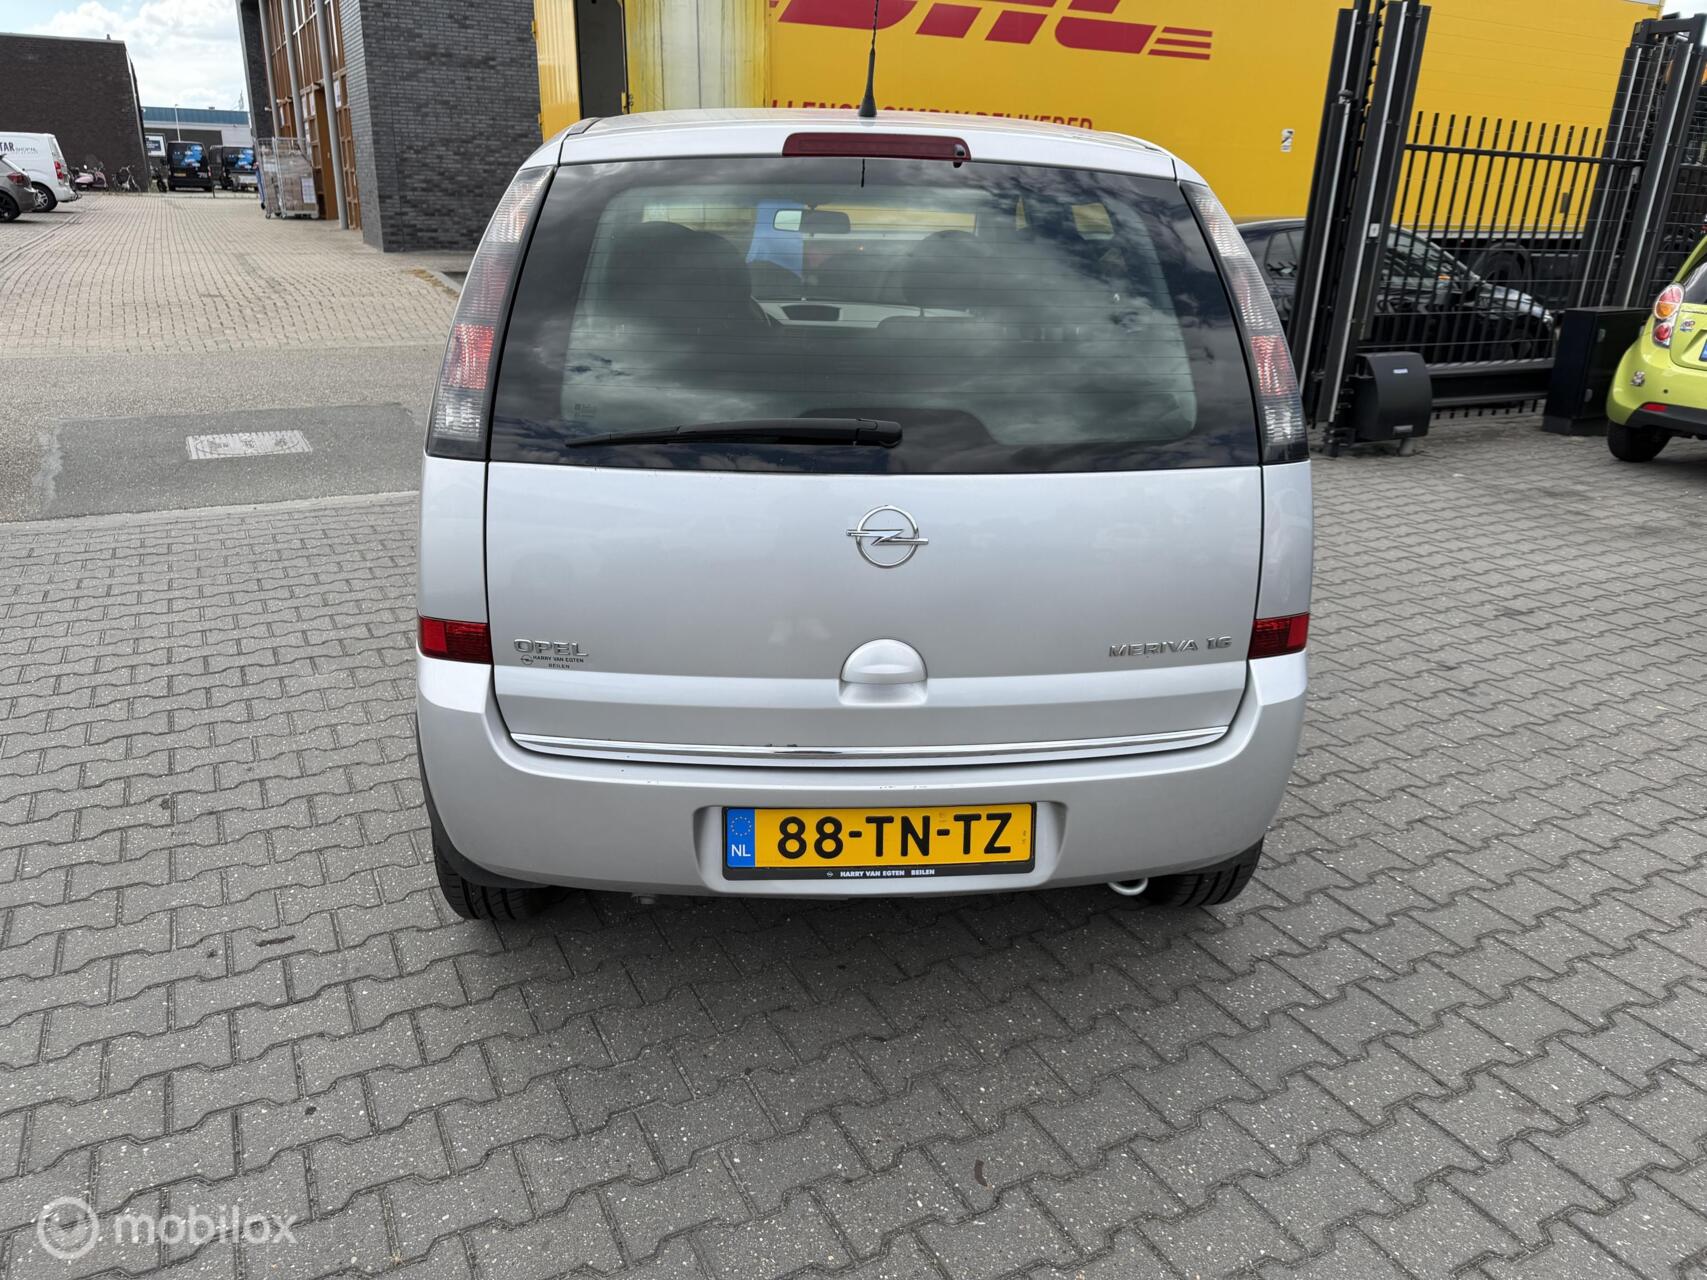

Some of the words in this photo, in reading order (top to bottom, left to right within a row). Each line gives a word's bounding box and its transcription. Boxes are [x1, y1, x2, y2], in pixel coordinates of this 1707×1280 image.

[514, 639, 589, 656] OPEL
[1109, 640, 1198, 657] MERIVA
[777, 812, 1012, 859] 88-TN-TZ
[731, 844, 751, 857] NL
